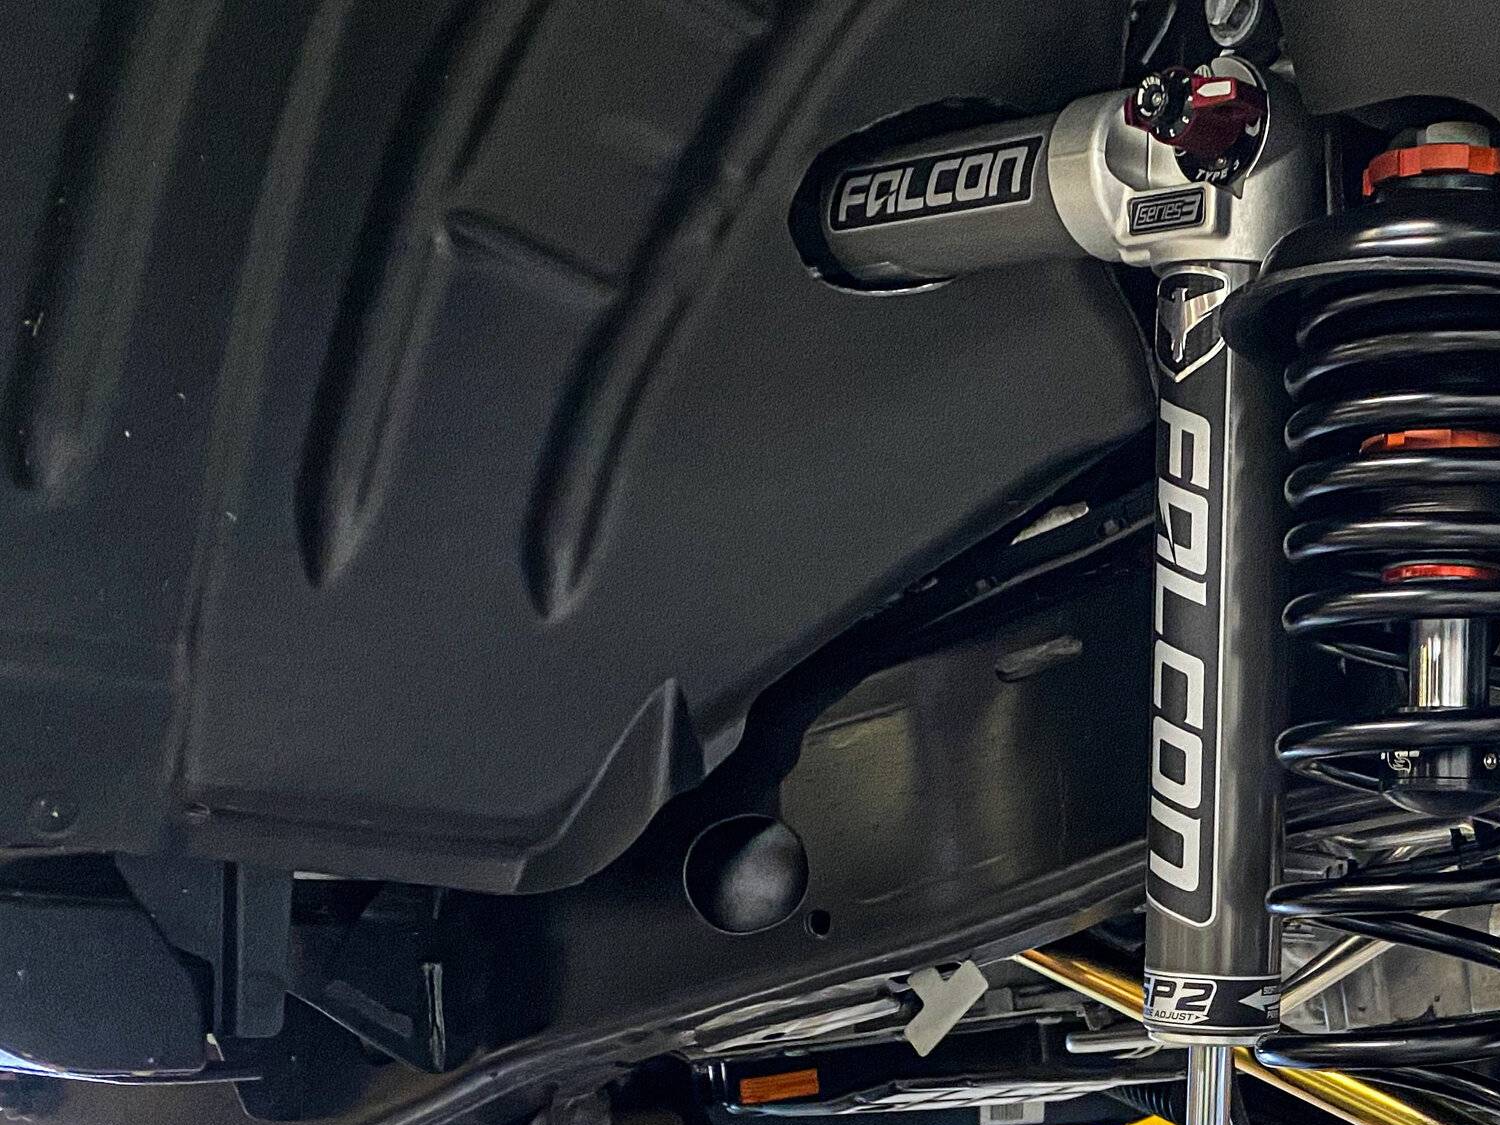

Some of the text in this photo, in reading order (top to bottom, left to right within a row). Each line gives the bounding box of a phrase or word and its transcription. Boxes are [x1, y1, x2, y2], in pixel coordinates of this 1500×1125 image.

[838, 146, 1029, 222] FALCON
[1195, 168, 1229, 182] TYPE
[1149, 398, 1212, 893] FALCON
[1154, 1010, 1194, 1021] ADJUST
